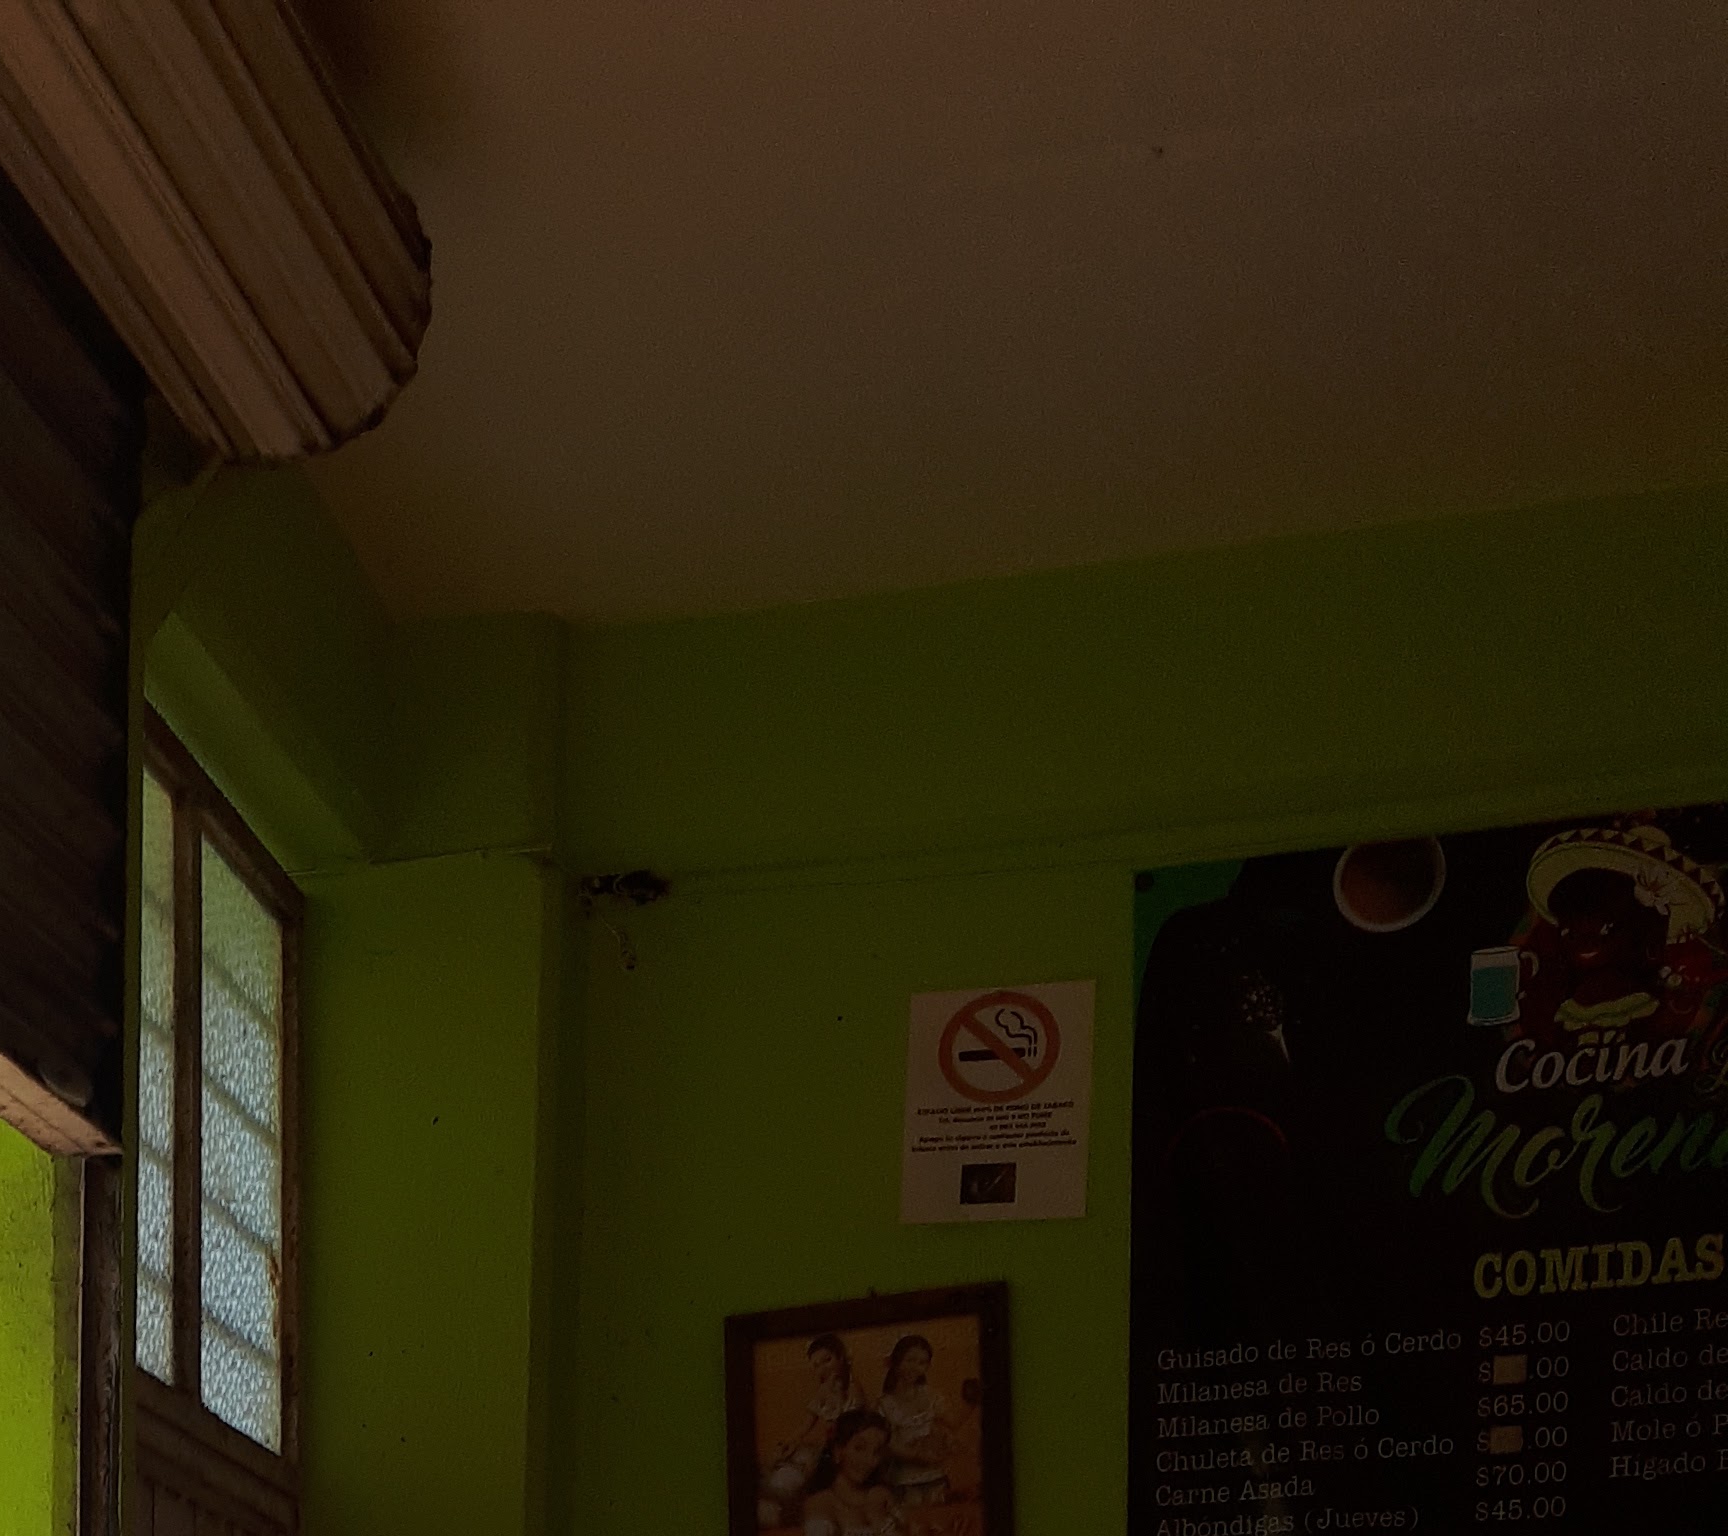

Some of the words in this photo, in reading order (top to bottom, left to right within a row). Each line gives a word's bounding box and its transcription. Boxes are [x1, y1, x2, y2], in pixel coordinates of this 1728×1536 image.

[1495, 1037, 1690, 1093] Cocina
[1474, 1234, 1725, 1299] COMIDAS
[1479, 1321, 1570, 1348] $45.00
[1613, 1312, 1683, 1336] Chile
[1158, 1343, 1258, 1370] Guisado
[1268, 1339, 1296, 1360] de
[1306, 1338, 1351, 1359] Res
[1361, 1333, 1375, 1356] ó
[1385, 1329, 1461, 1354] Cerdo
[1612, 1347, 1688, 1372] Caldo
[1478, 1354, 1569, 1384] $.00
[1157, 1380, 1270, 1404] Milanesa
[1279, 1373, 1307, 1394] de
[1317, 1372, 1362, 1392] Res
[1611, 1383, 1687, 1408] Caldo
[1477, 1391, 1568, 1417] $65.00
[1157, 1414, 1270, 1438] Milanesa
[1278, 1407, 1307, 1428] de
[1317, 1405, 1380, 1426] Pollo
[1611, 1418, 1676, 1442] Mole
[1156, 1448, 1254, 1472] Chuleta
[1261, 1443, 1290, 1464] de
[1299, 1440, 1344, 1461] Res
[1354, 1437, 1368, 1460] ó
[1378, 1435, 1454, 1458] Cerdo
[1477, 1425, 1568, 1455] $.00
[1476, 1460, 1567, 1487] $70.00
[1156, 1485, 1230, 1506] Carne
[1238, 1475, 1314, 1501] Asada
[1304, 1507, 1418, 1533] (Jueves)
[1475, 1496, 1566, 1521] $45.00
